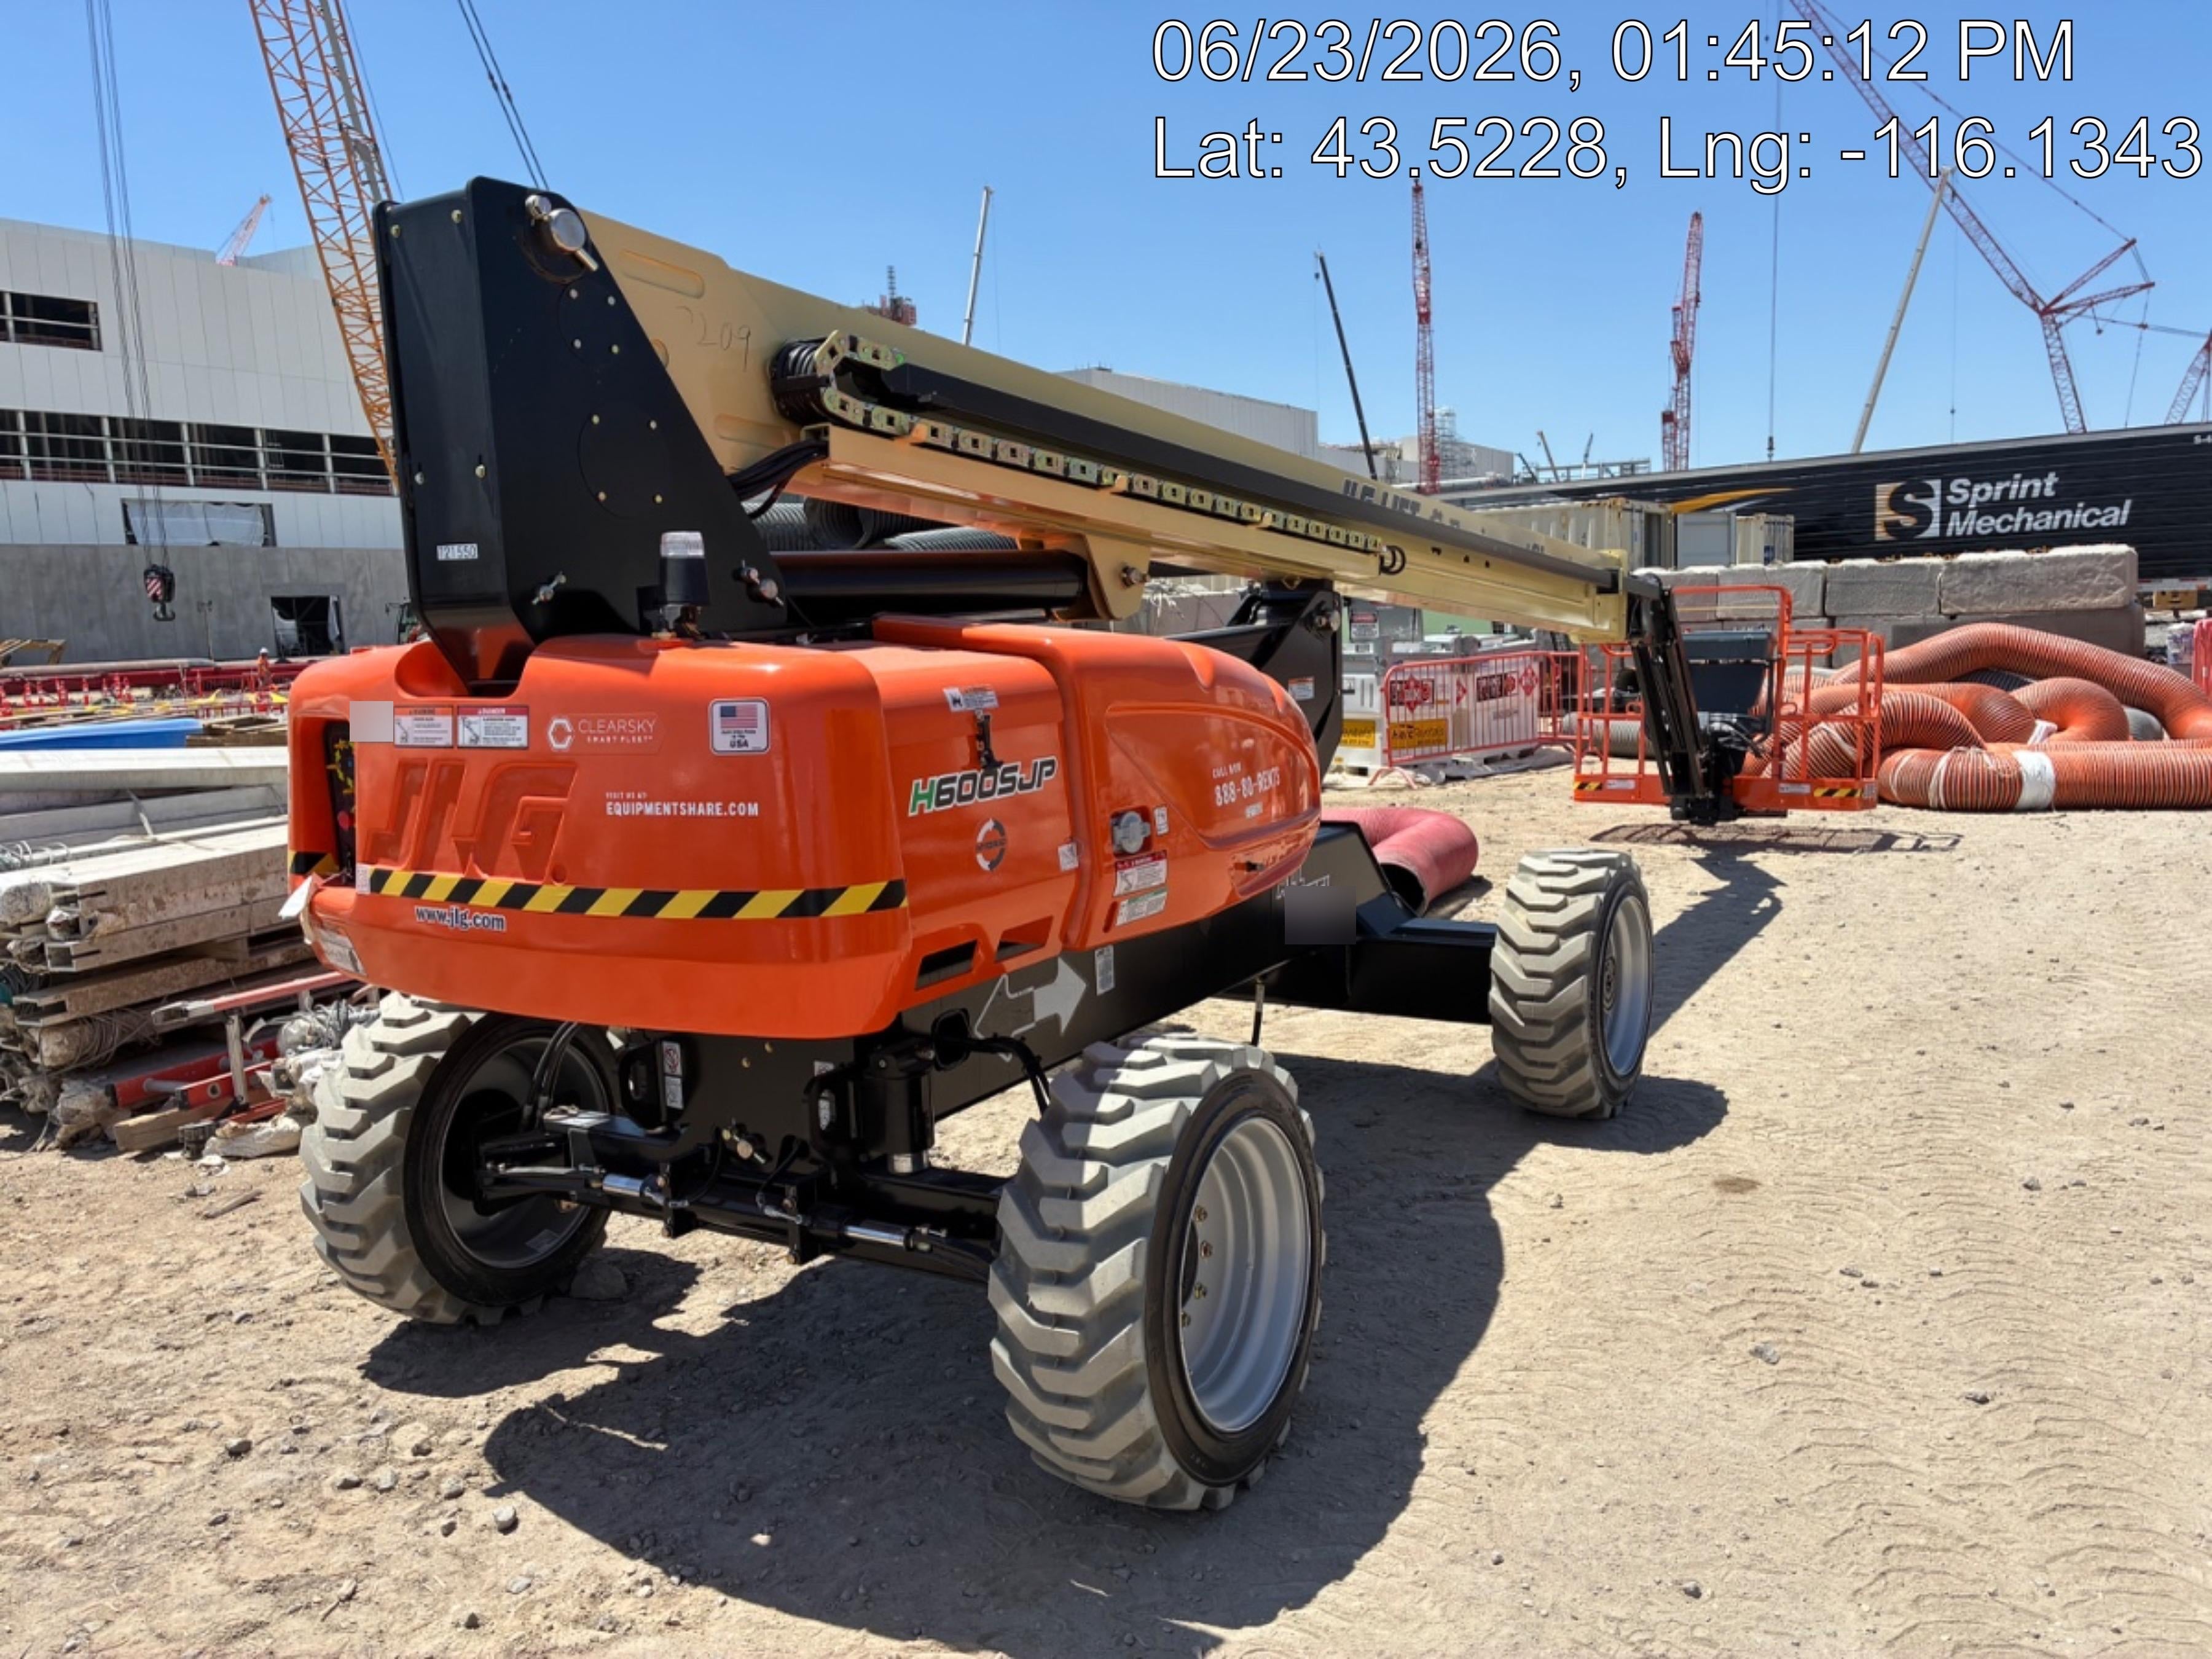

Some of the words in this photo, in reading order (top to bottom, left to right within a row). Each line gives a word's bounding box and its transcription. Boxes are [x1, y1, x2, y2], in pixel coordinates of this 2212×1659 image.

[1947, 471, 2060, 506] Sprint
[1946, 499, 2132, 537] Mechanical
[578, 718, 656, 734] CLEARSKY
[729, 739, 749, 748] USA
[908, 756, 1058, 817] H600SJP
[362, 758, 580, 885] JLG
[605, 801, 759, 817] EQUIPMENTSHARE.COM
[414, 905, 506, 931] www.jlg.com
